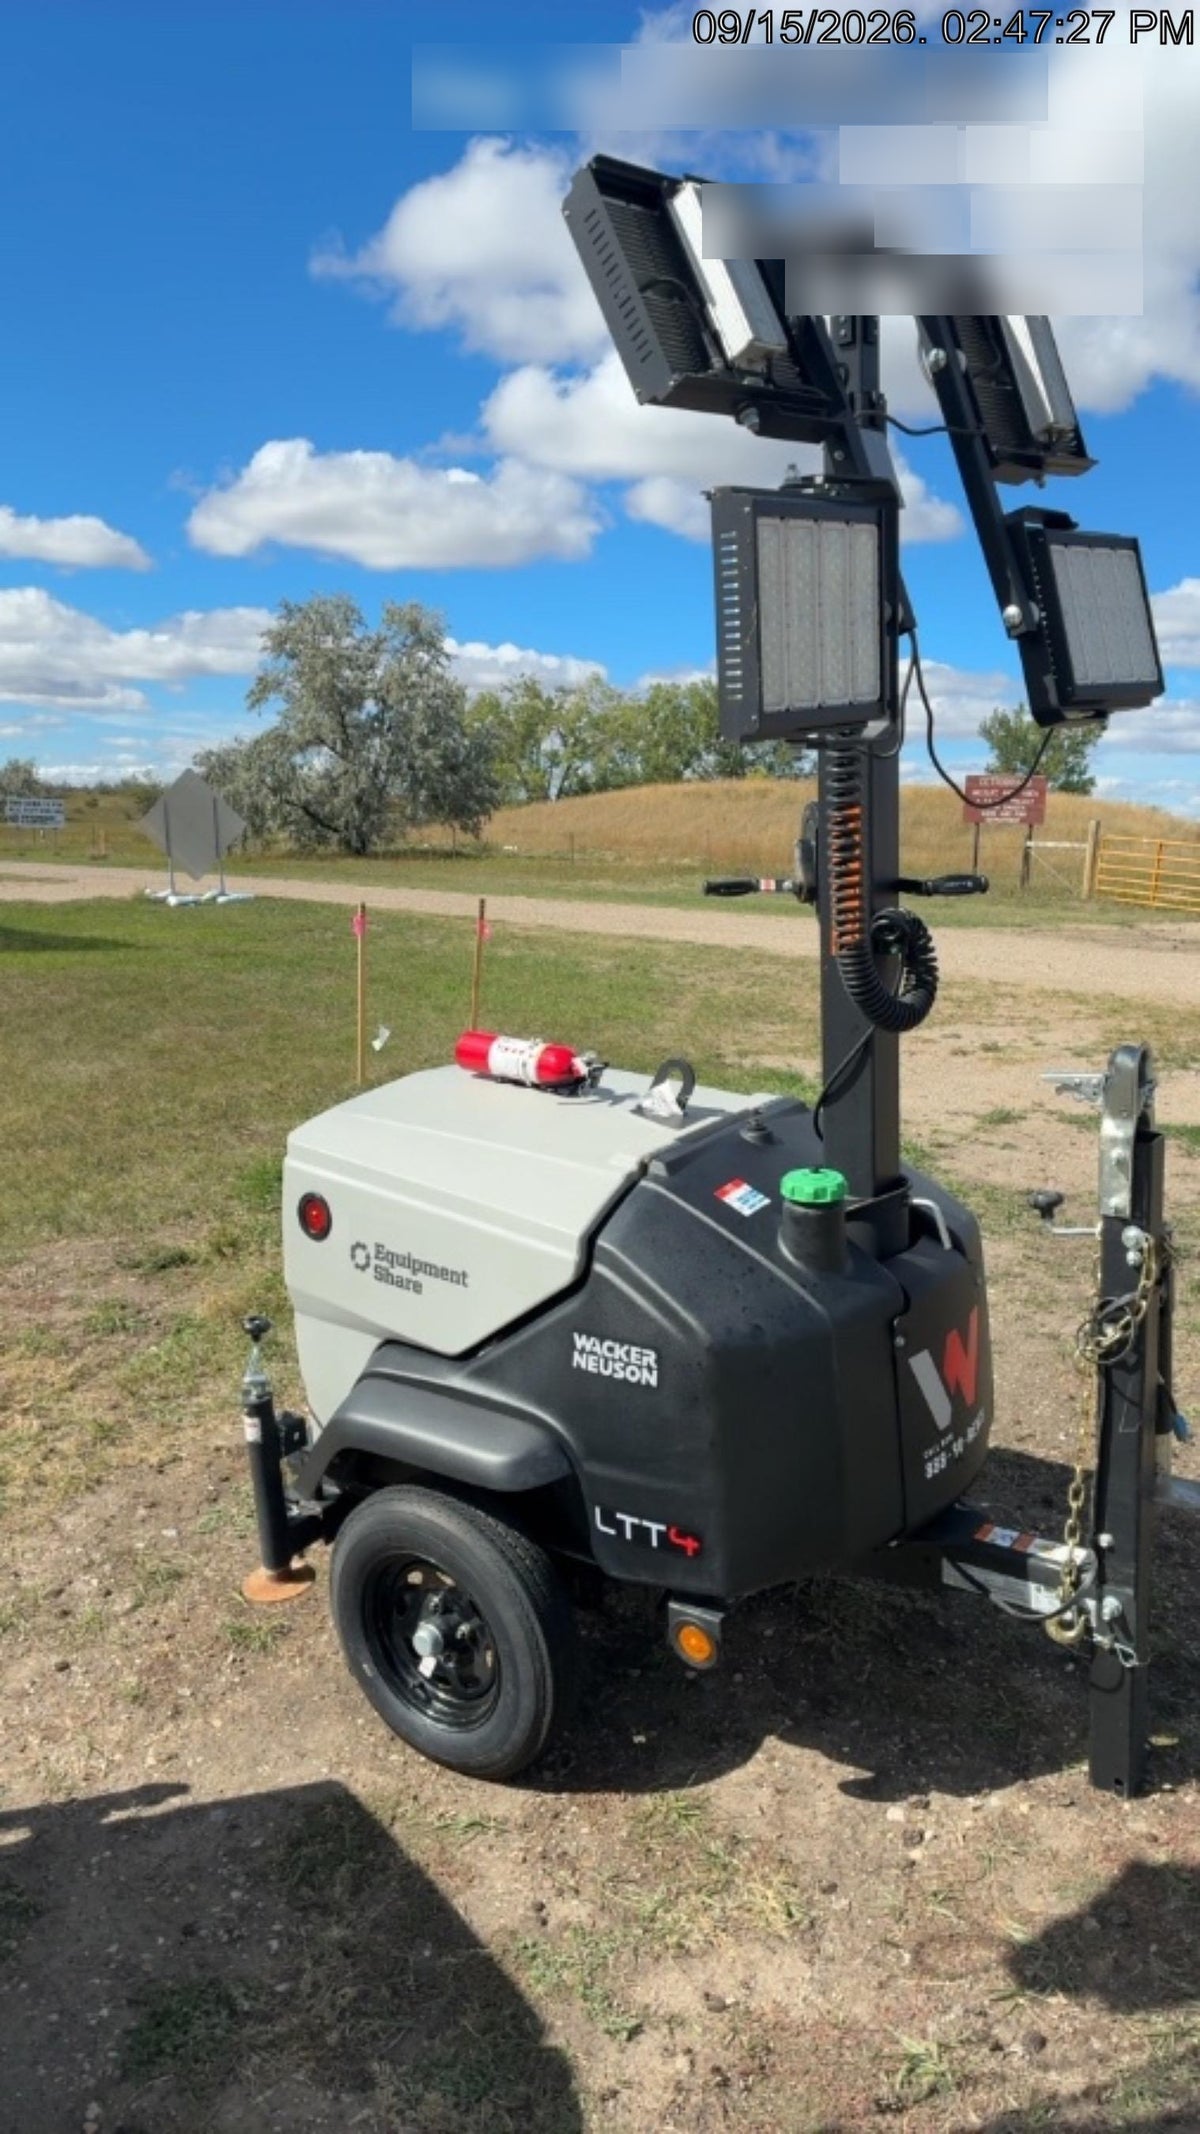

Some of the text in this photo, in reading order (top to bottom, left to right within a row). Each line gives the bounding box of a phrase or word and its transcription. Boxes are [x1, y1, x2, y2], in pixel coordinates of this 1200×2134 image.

[373, 1242, 469, 1288] Equipment
[373, 1264, 424, 1295] Share
[572, 1332, 658, 1369] WACKER
[572, 1351, 658, 1388] NEUSON
[594, 1505, 702, 1558] LTT4
